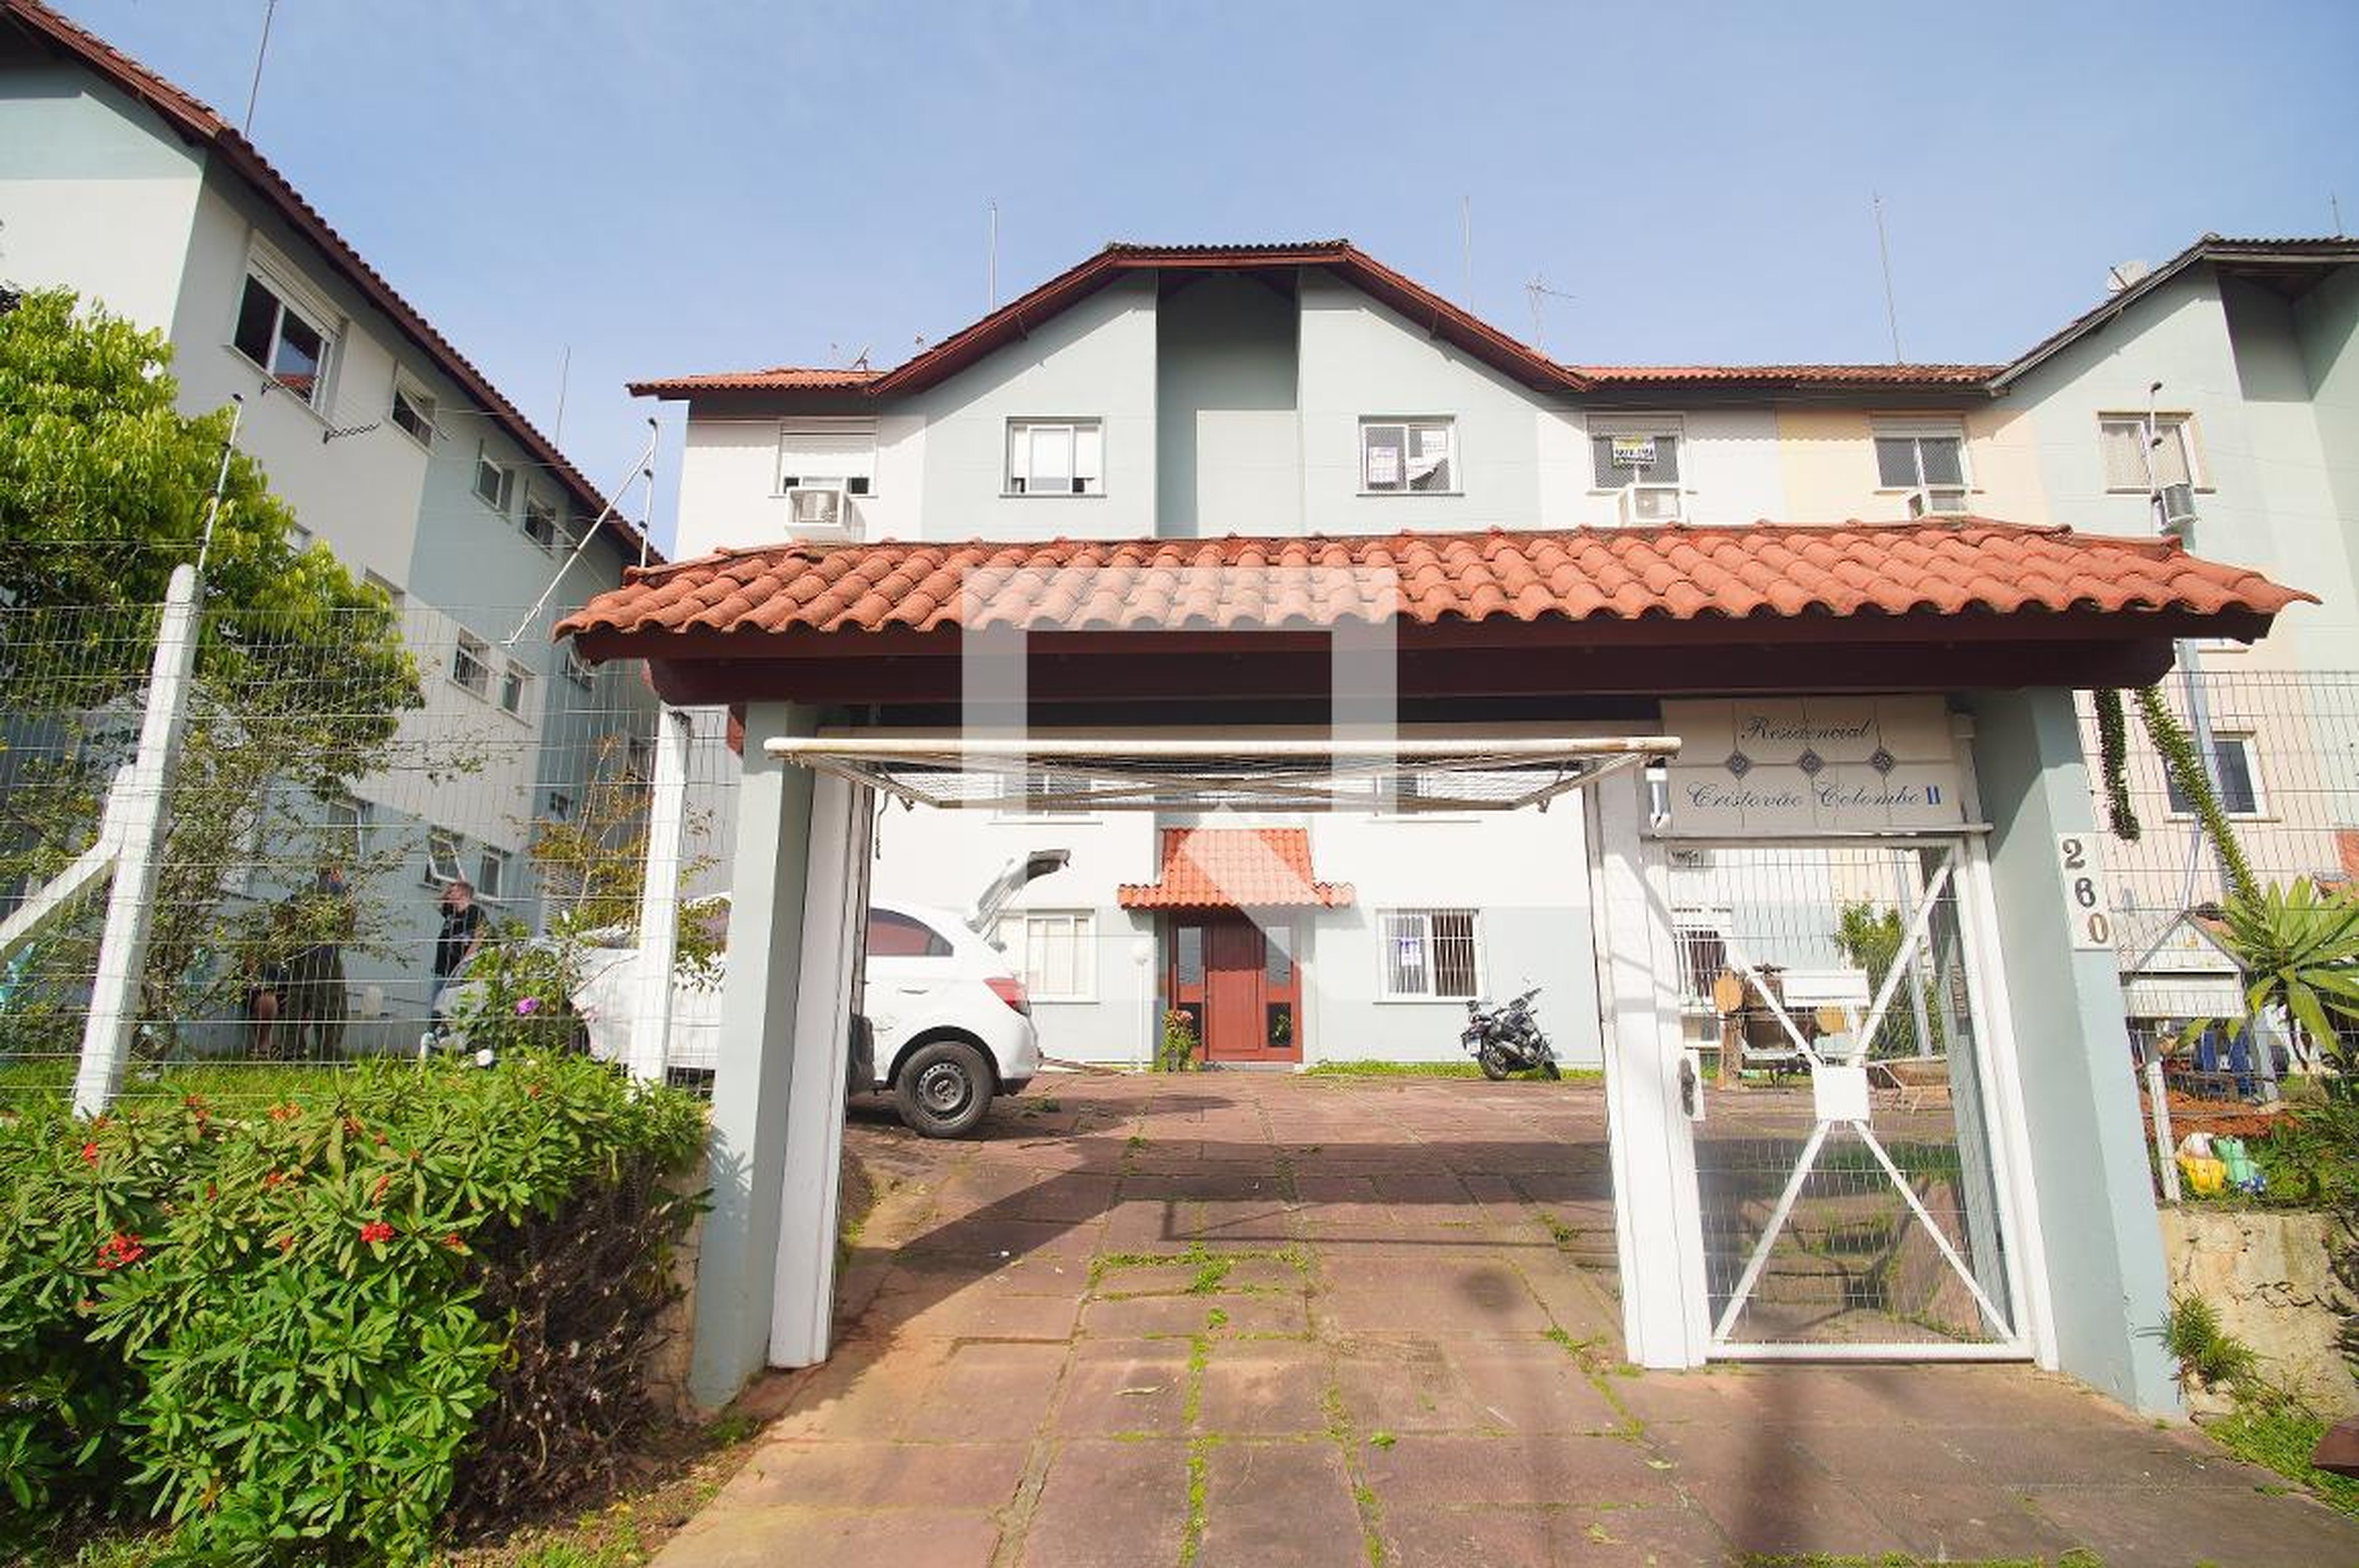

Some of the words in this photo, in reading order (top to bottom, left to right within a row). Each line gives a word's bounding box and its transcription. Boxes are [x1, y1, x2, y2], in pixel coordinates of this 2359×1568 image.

[1741, 716, 1872, 739] Residencial
[1815, 781, 1919, 808] Colombo
[2062, 838, 2109, 944] 260
